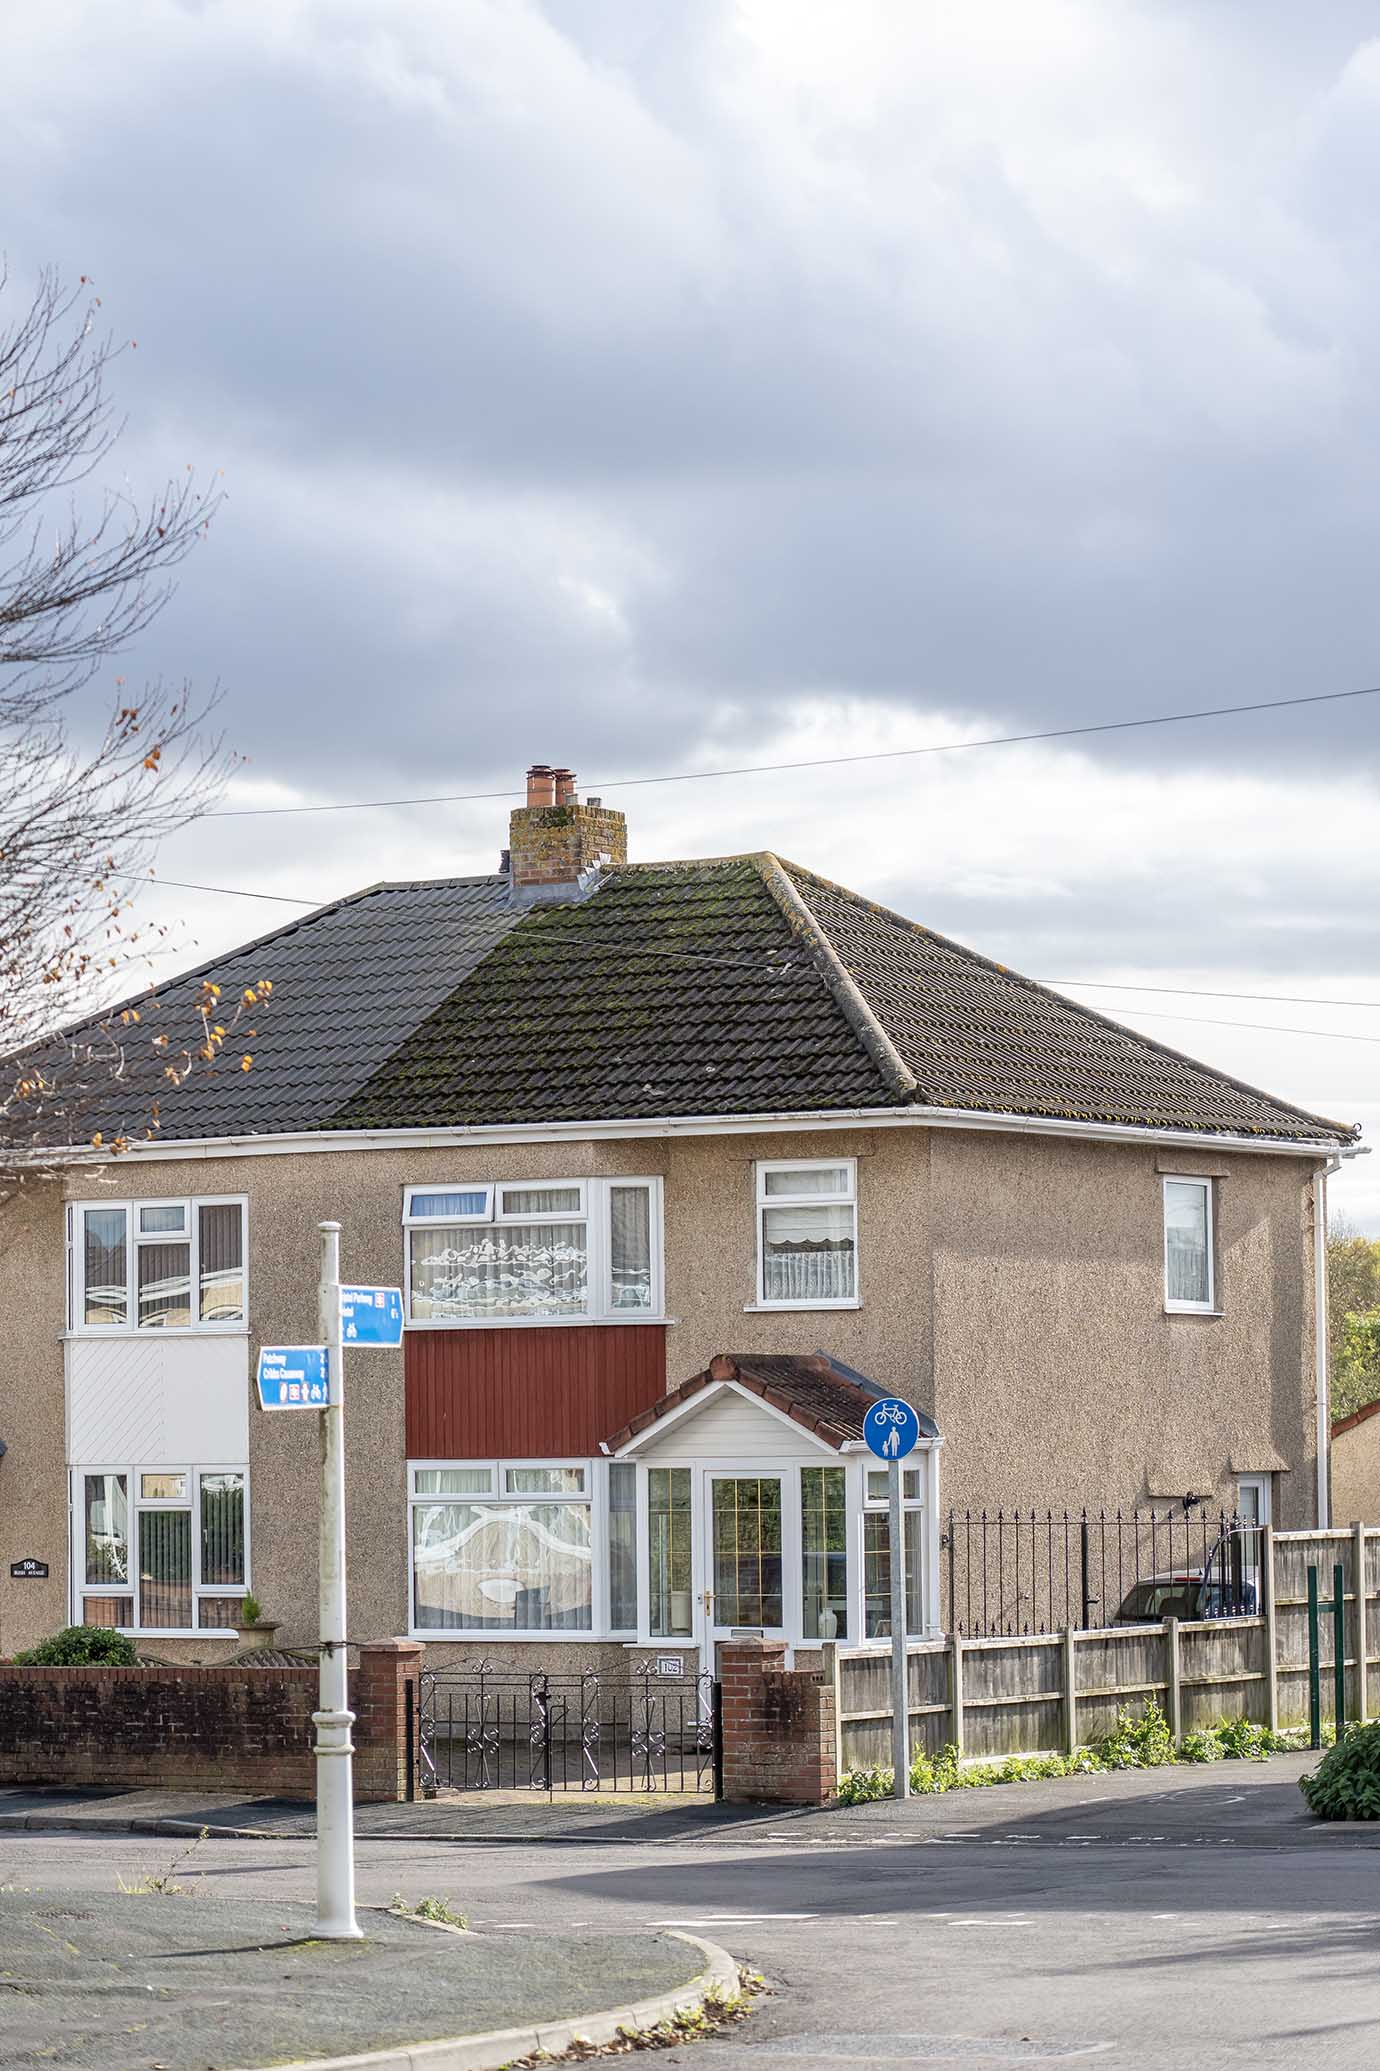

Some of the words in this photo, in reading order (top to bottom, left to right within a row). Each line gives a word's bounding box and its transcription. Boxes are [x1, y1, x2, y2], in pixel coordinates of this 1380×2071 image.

[263, 1353, 287, 1367] Patchway
[23, 1561, 36, 1570] 104
[664, 1663, 678, 1672] 102
